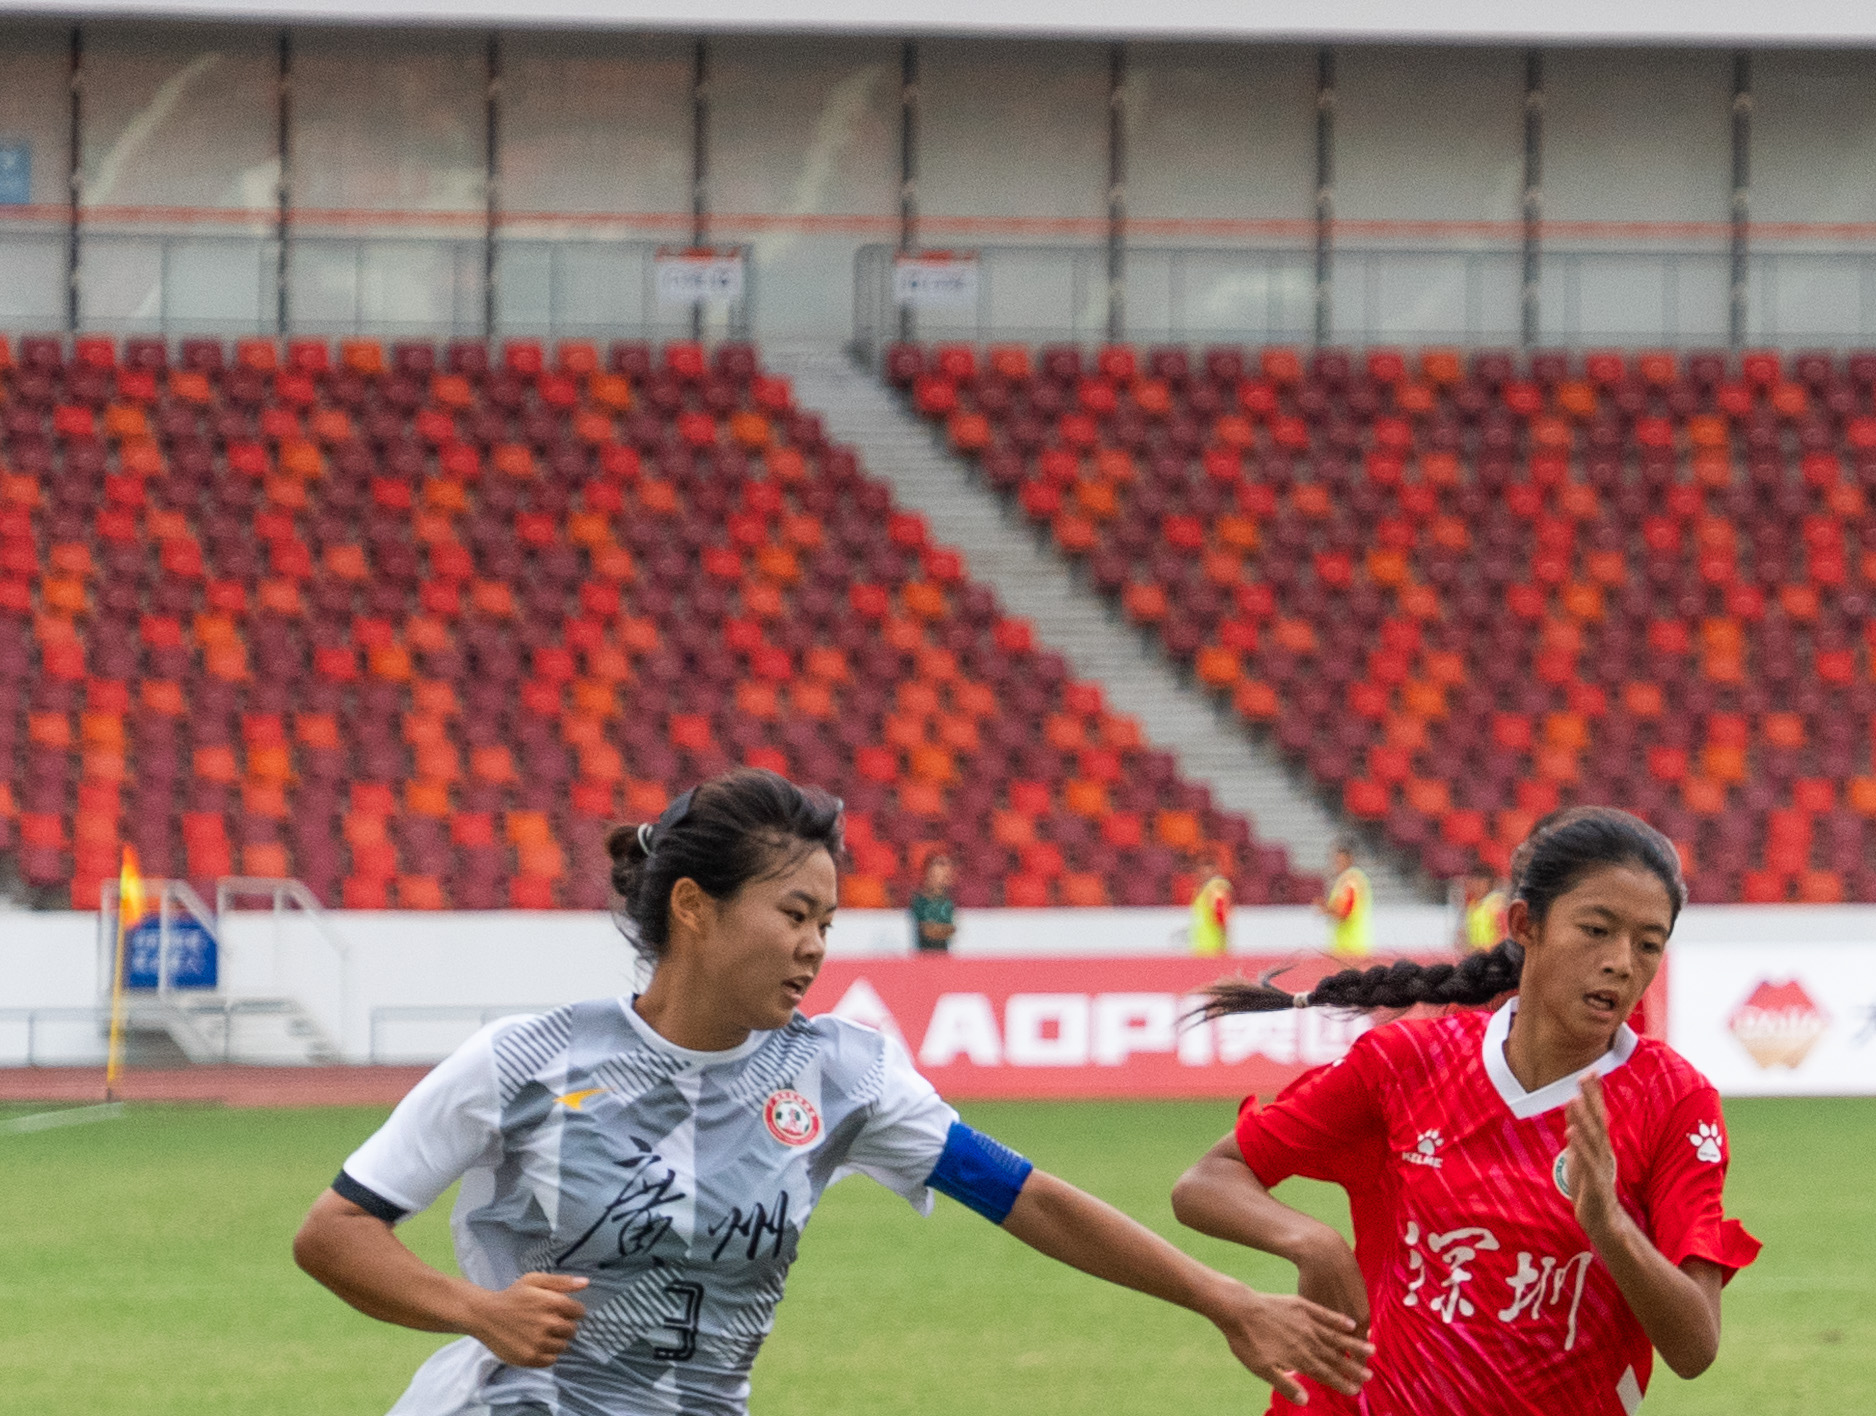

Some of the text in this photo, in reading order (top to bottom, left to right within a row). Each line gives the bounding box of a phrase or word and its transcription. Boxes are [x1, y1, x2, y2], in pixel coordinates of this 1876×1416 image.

[1401, 1151, 1444, 1169] KELME
[653, 1279, 704, 1361] 3
[1402, 1221, 1592, 1351] 深圳
